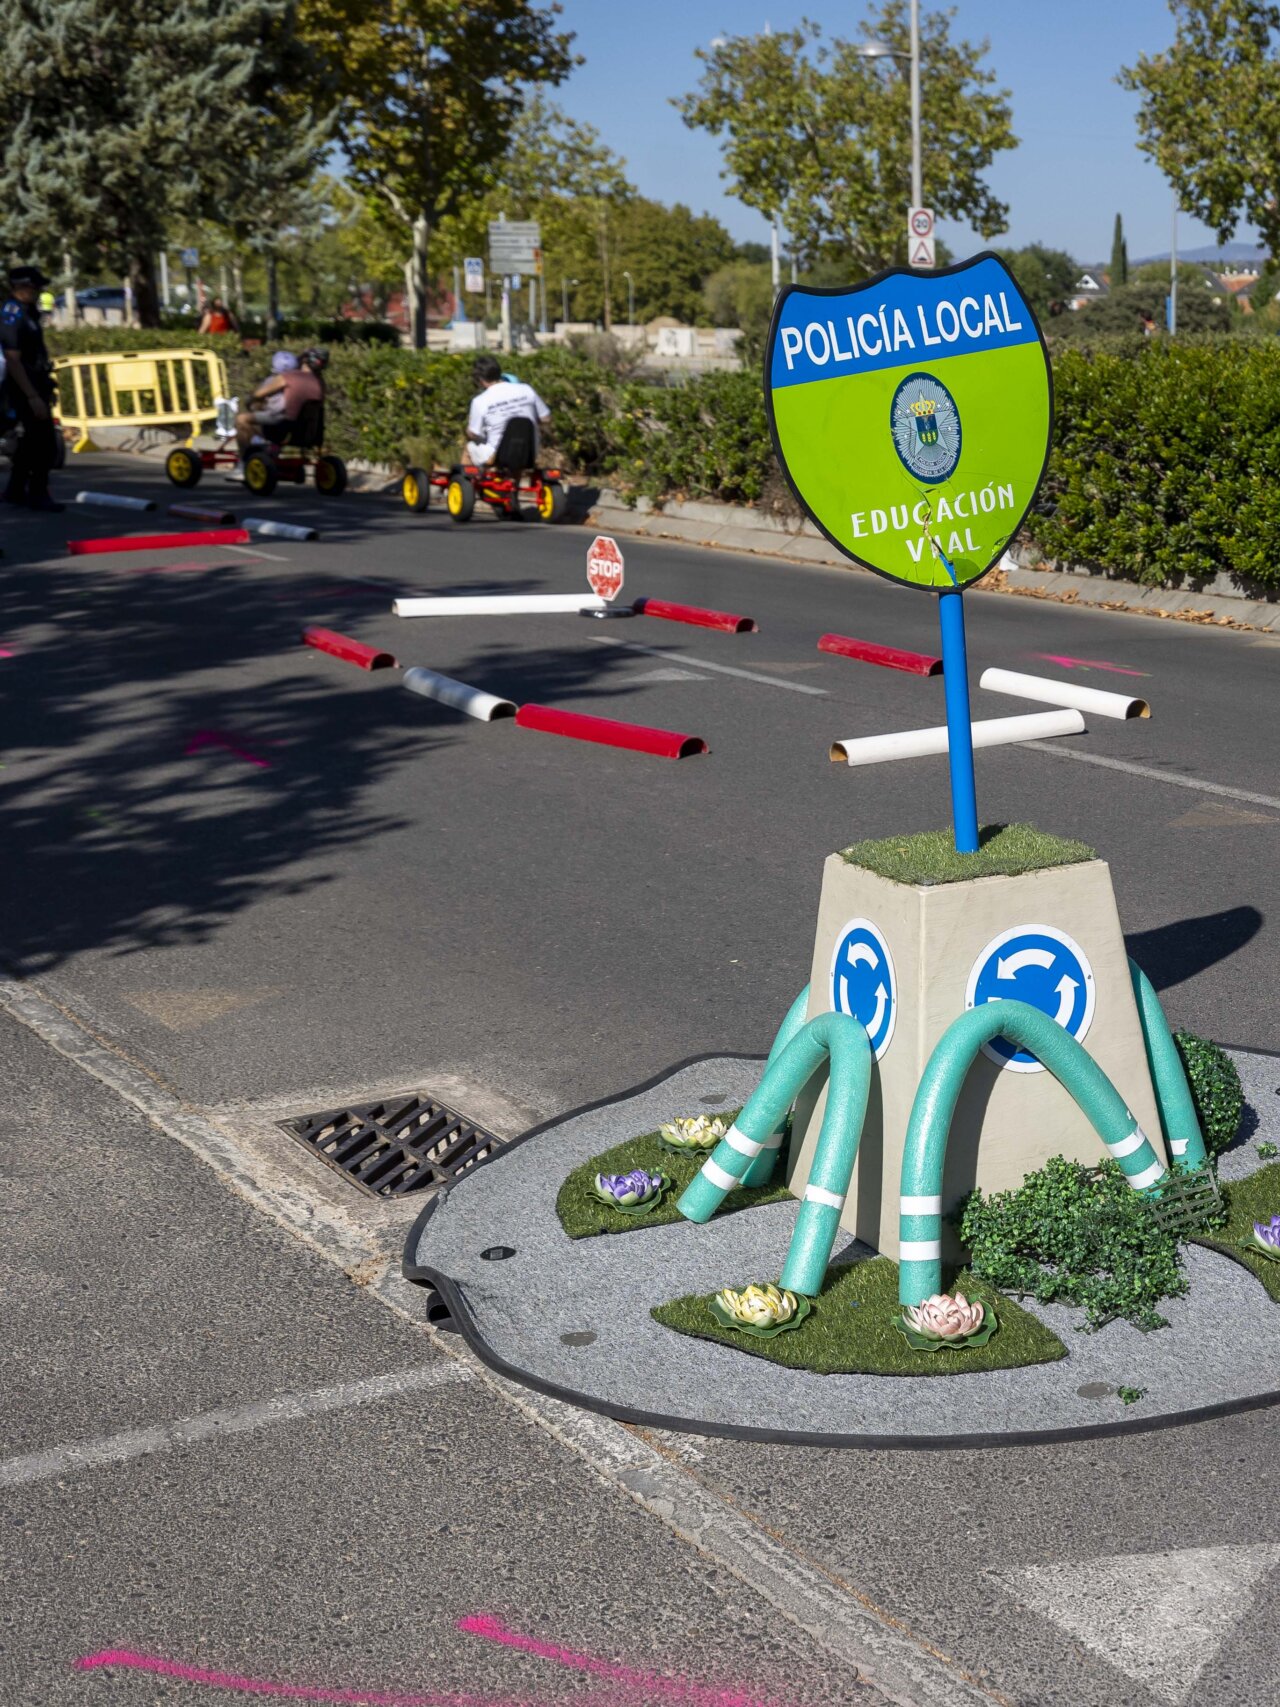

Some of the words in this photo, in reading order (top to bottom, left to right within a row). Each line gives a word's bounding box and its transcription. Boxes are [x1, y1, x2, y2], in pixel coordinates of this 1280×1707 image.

[780, 304, 916, 370] POLICÍA
[917, 291, 1022, 346] LOCAL
[851, 481, 1015, 538] EDUCACIÓN
[905, 528, 981, 562] VIAL
[589, 558, 621, 578] STOP
